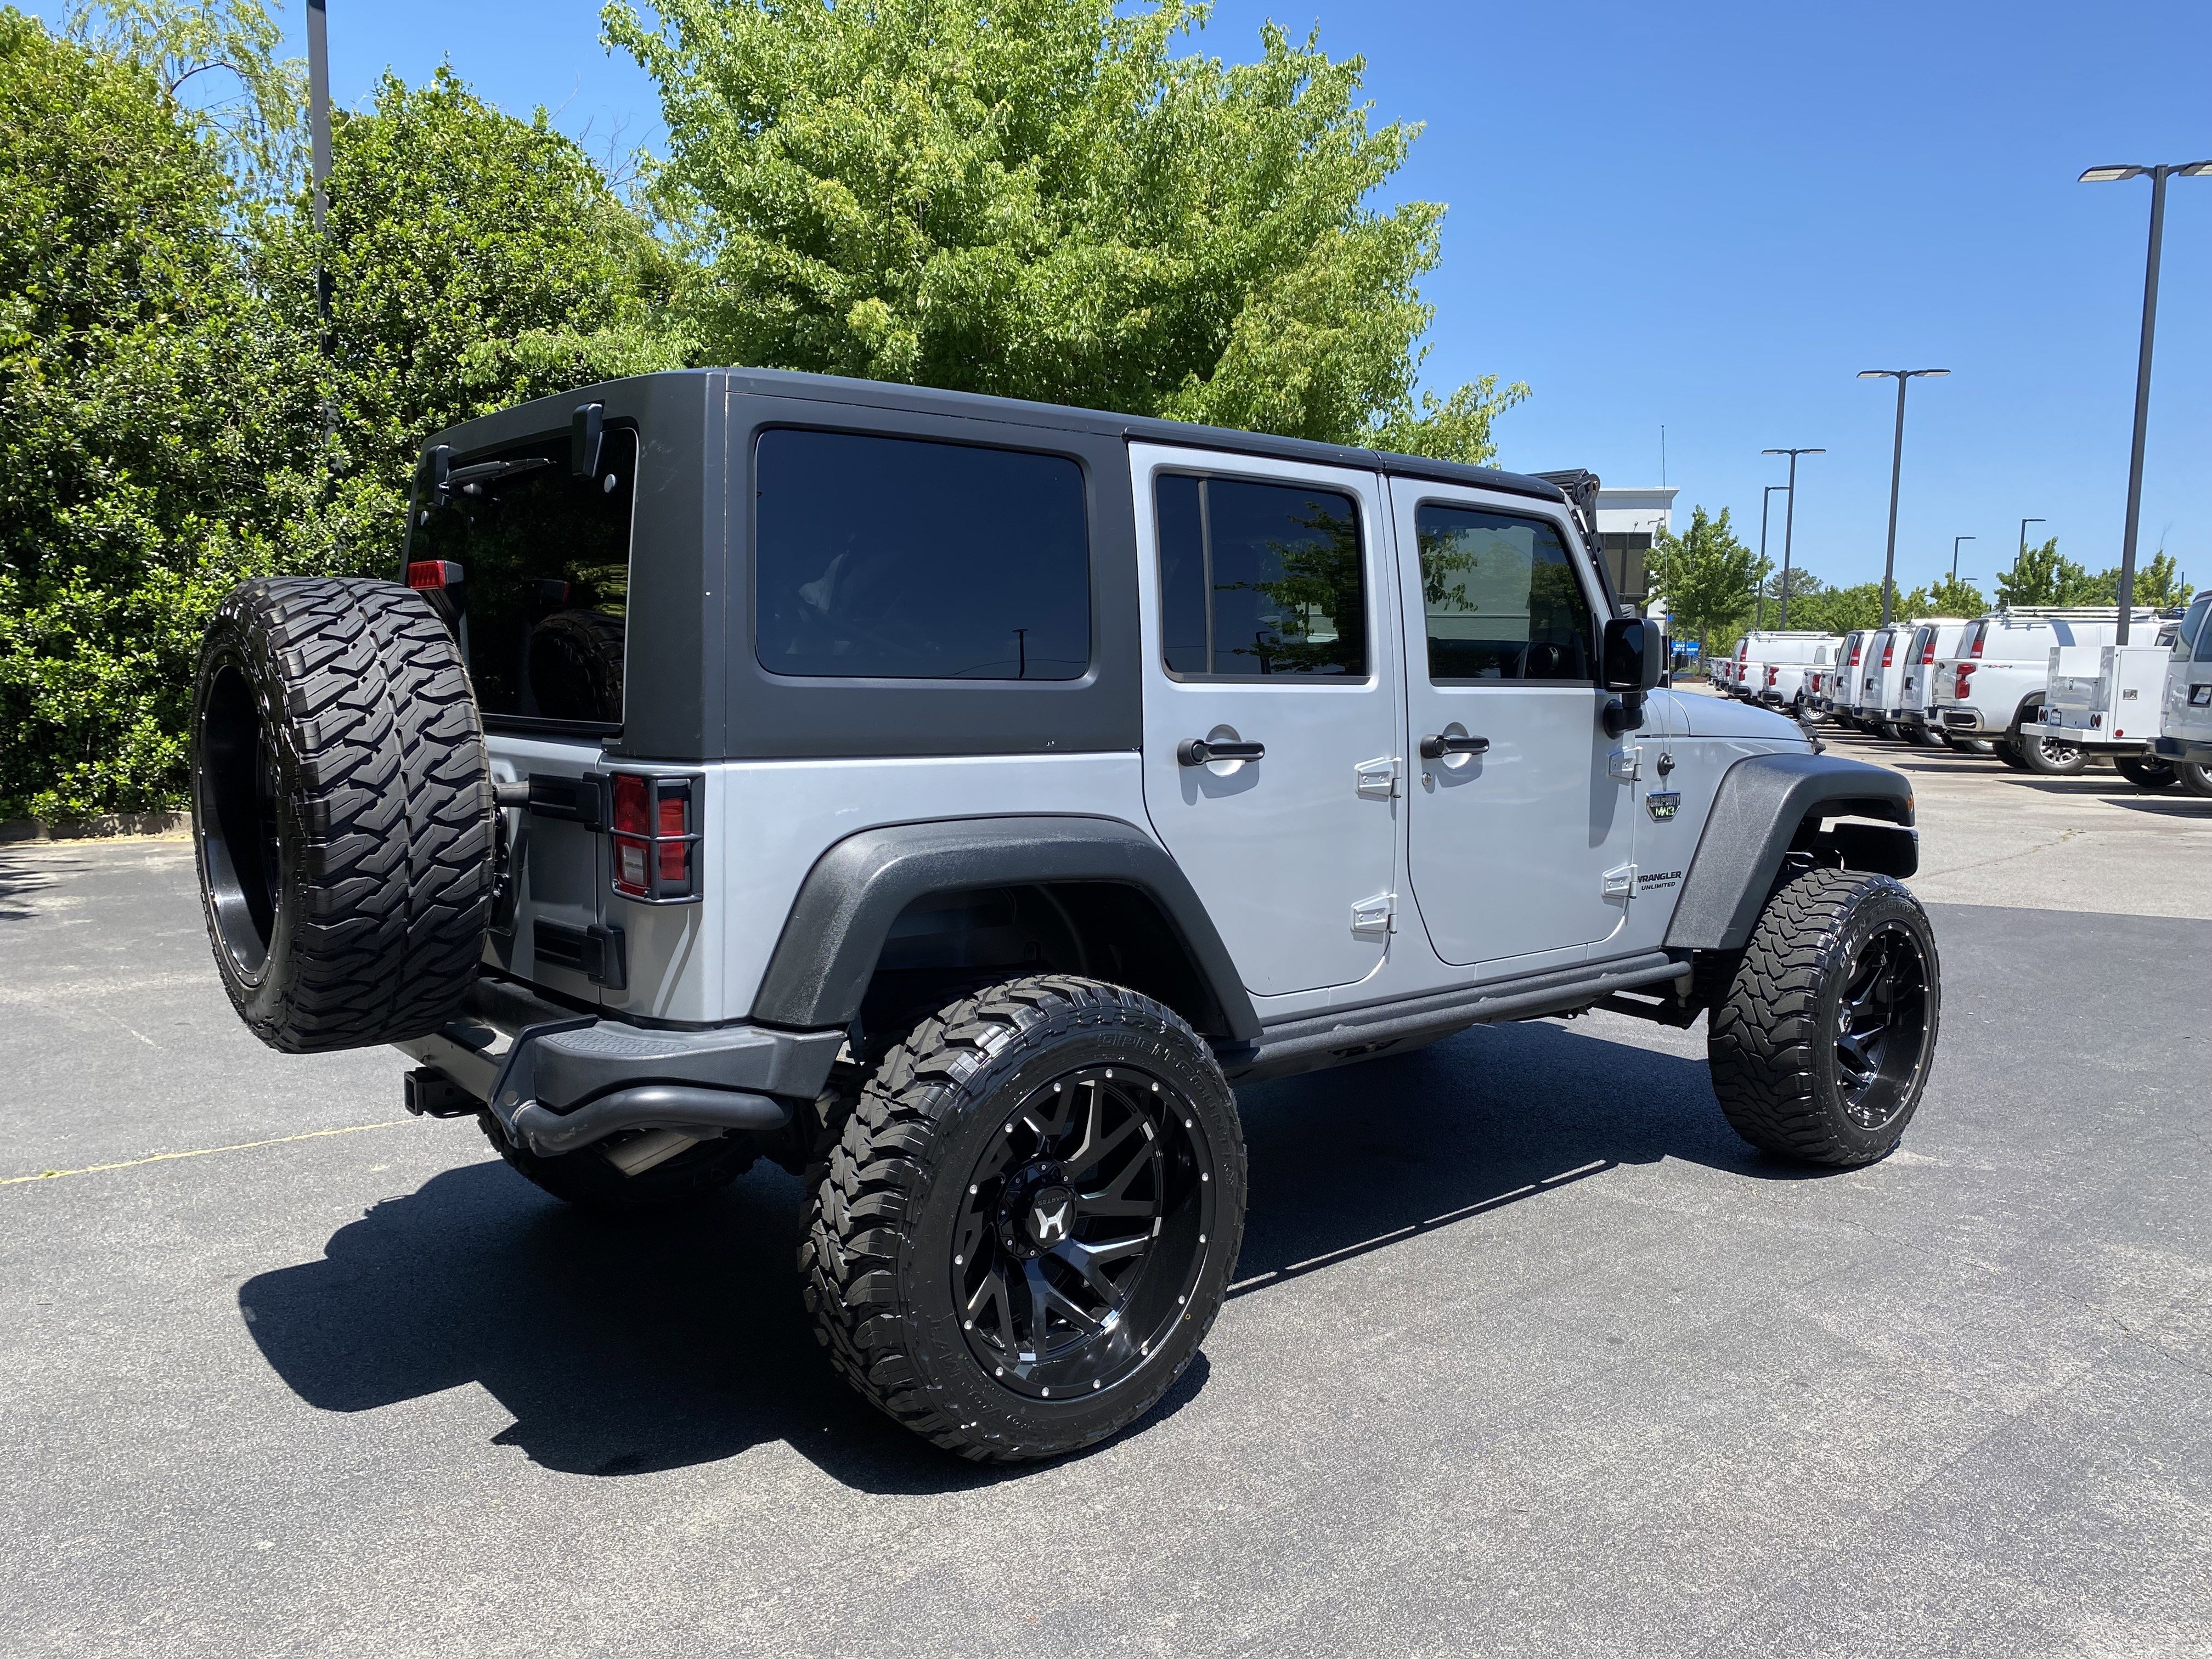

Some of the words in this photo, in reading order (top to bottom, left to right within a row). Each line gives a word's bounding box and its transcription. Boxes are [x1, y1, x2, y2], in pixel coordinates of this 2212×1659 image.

[1656, 806, 1674, 816] MW3
[1641, 882, 1675, 890] UNLIMITED
[1839, 920, 1866, 969] OPEN
[1097, 1033, 1171, 1061] OPEN
[1037, 1195, 1065, 1206] HARTES
